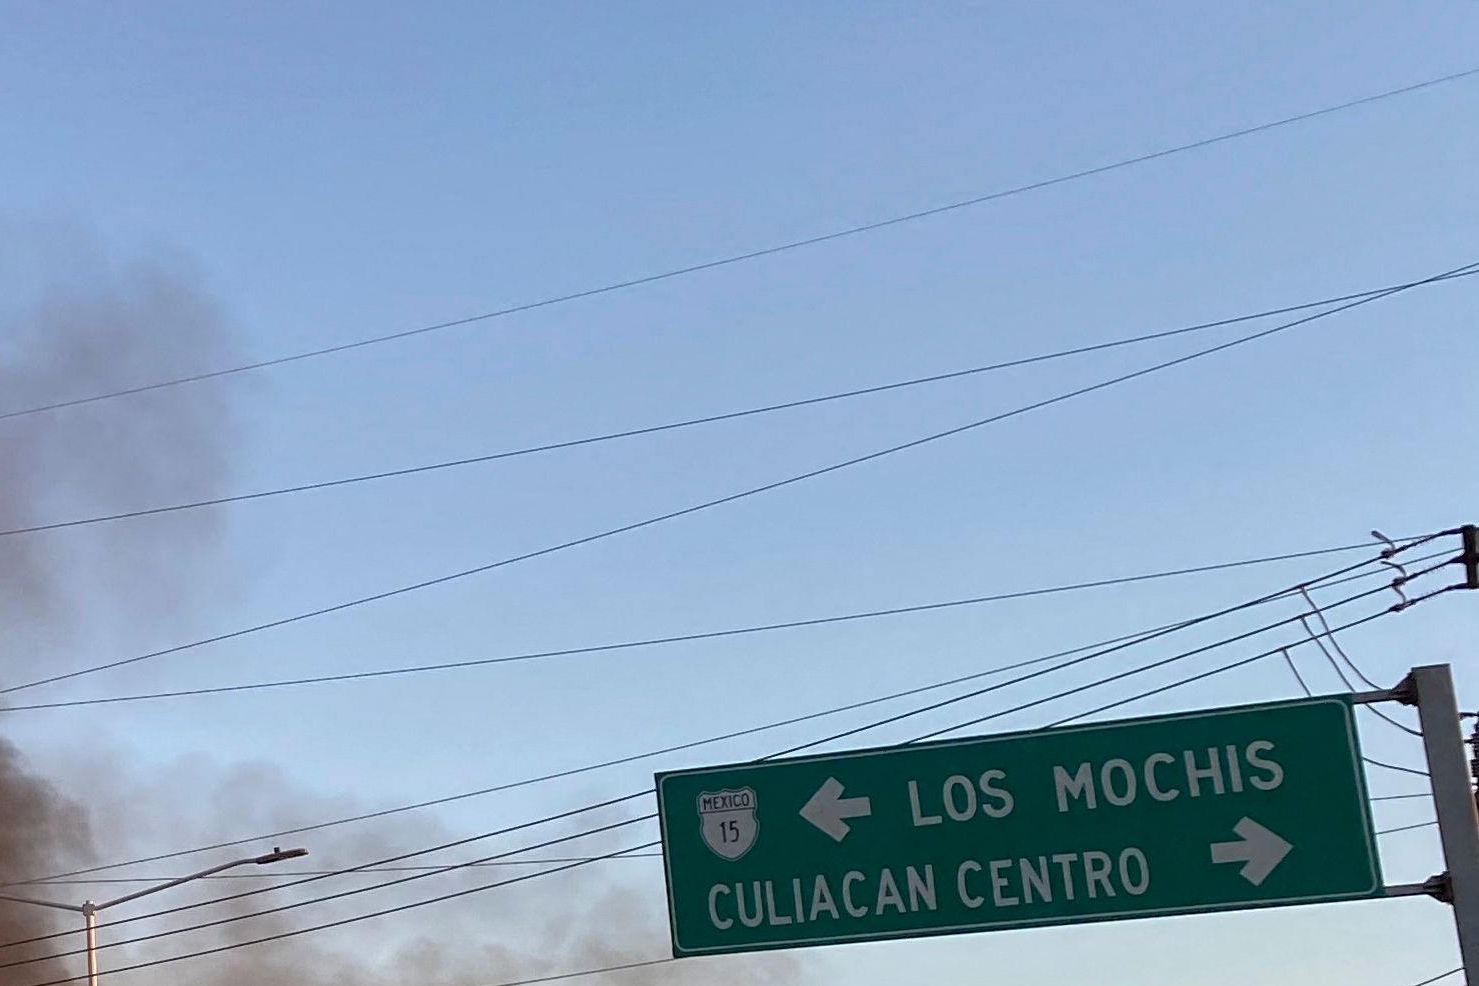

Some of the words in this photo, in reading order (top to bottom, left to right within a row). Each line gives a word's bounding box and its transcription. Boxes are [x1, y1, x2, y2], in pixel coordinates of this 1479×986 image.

[702, 792, 751, 811] MEXICO
[908, 769, 1015, 827] LOS
[1053, 740, 1284, 812] MOCHIS
[719, 820, 740, 844] 15
[708, 863, 938, 930] CULIACAN
[957, 847, 1150, 909] CENTRO
